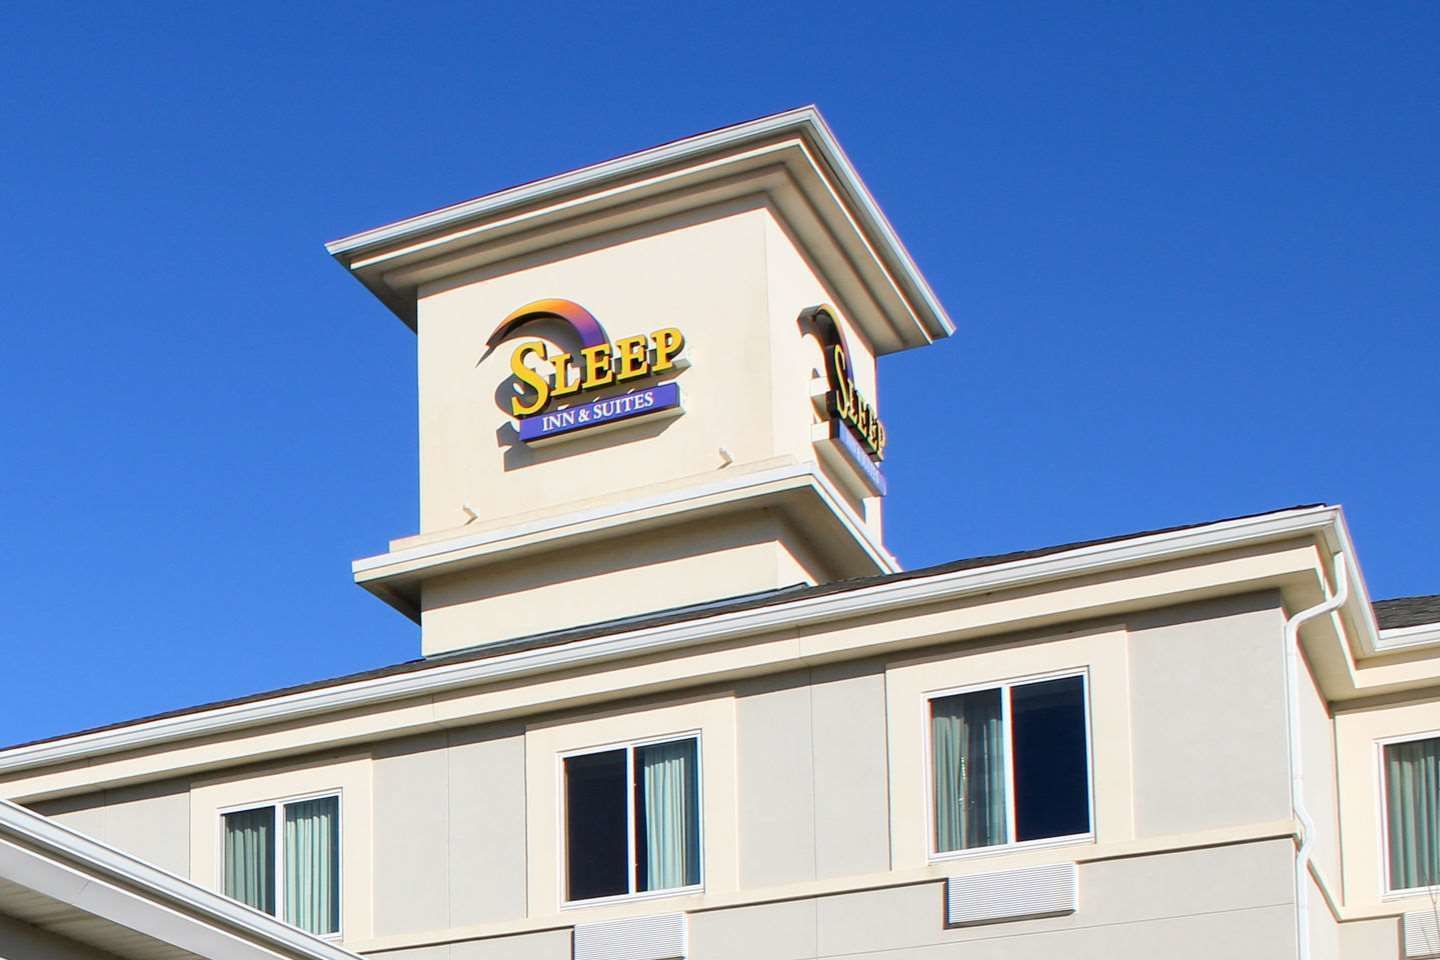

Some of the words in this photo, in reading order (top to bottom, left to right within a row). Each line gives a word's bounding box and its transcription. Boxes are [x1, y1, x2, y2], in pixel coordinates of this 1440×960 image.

[510, 327, 682, 416] SLEEP
[542, 412, 575, 431] INN
[578, 403, 590, 422] &
[594, 392, 654, 419] SUITES
